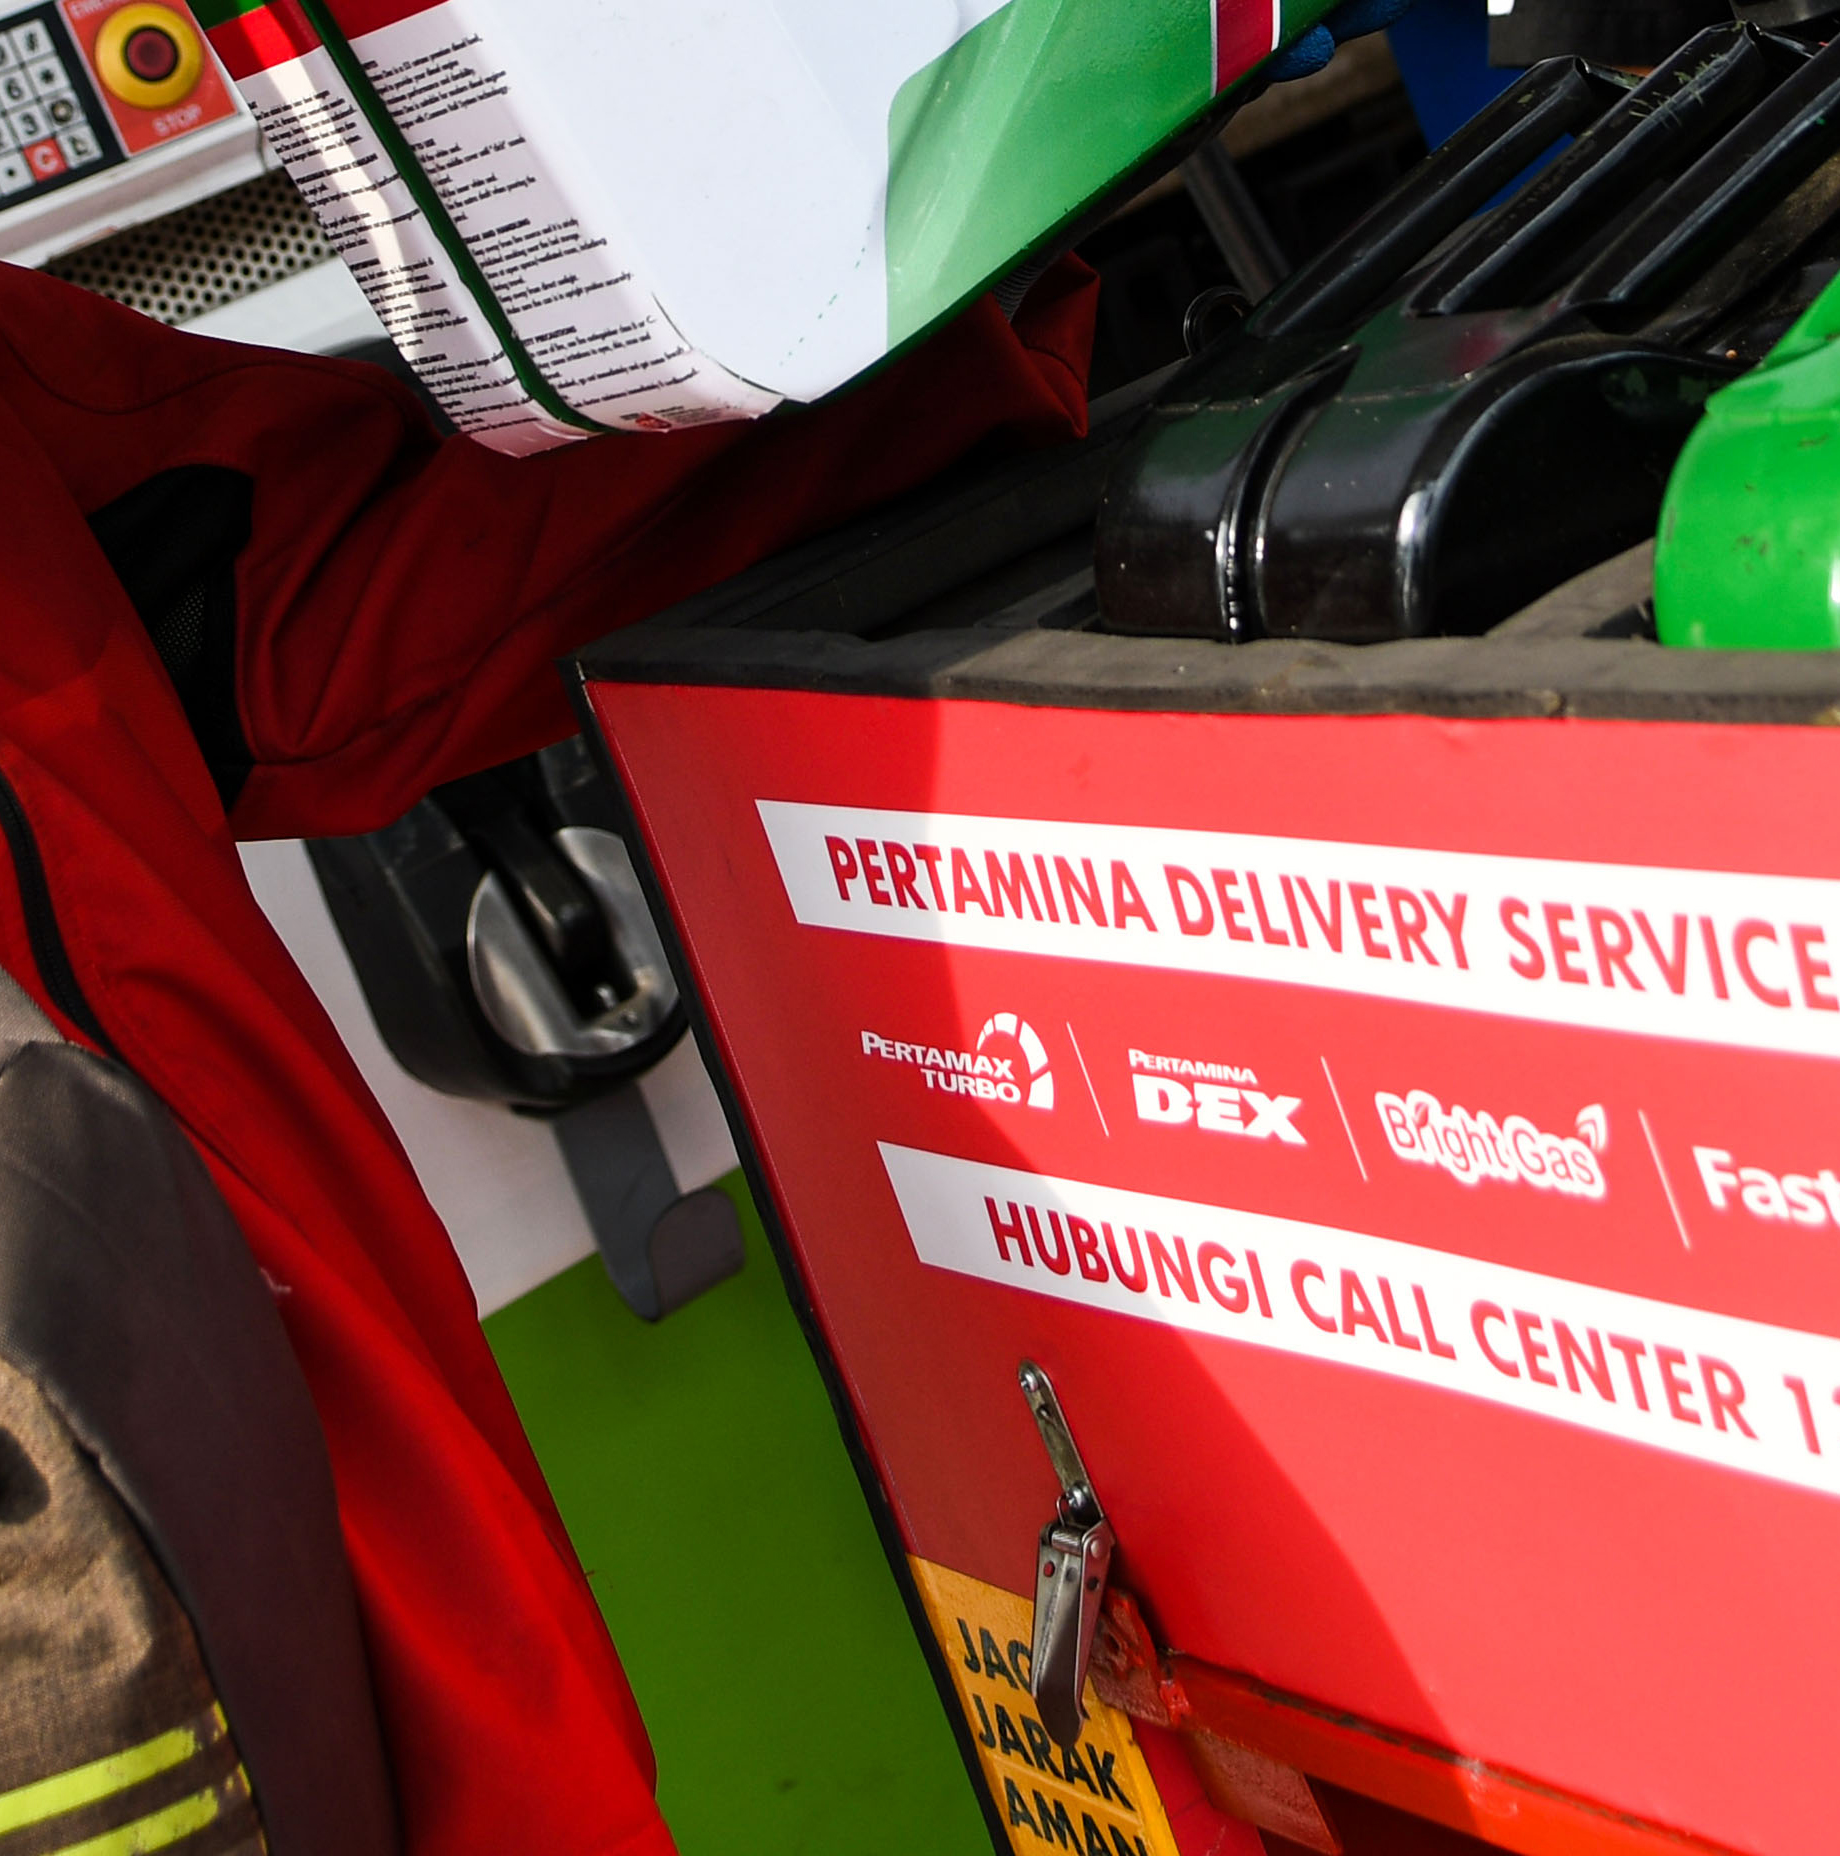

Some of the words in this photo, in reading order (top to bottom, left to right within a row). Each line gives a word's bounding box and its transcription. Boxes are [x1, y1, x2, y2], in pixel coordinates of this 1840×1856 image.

[6, 79, 24, 101] 6
[22, 113, 39, 136] 3
[152, 104, 202, 135] STOP
[32, 143, 59, 173] C
[823, 833, 1160, 934] PERTAMINA
[1162, 862, 1471, 971] DELIVERY
[860, 1028, 1016, 1083] PERTAMAX
[1126, 1047, 1259, 1086] PERTAMINA
[919, 1066, 1023, 1106] TURBO
[1131, 1072, 1308, 1146] DEX
[984, 1194, 1274, 1320] HUBUNGI
[1289, 1257, 1457, 1362] CALL
[1469, 1298, 1760, 1443] CENTER
[972, 1694, 1137, 1812] JARAK
